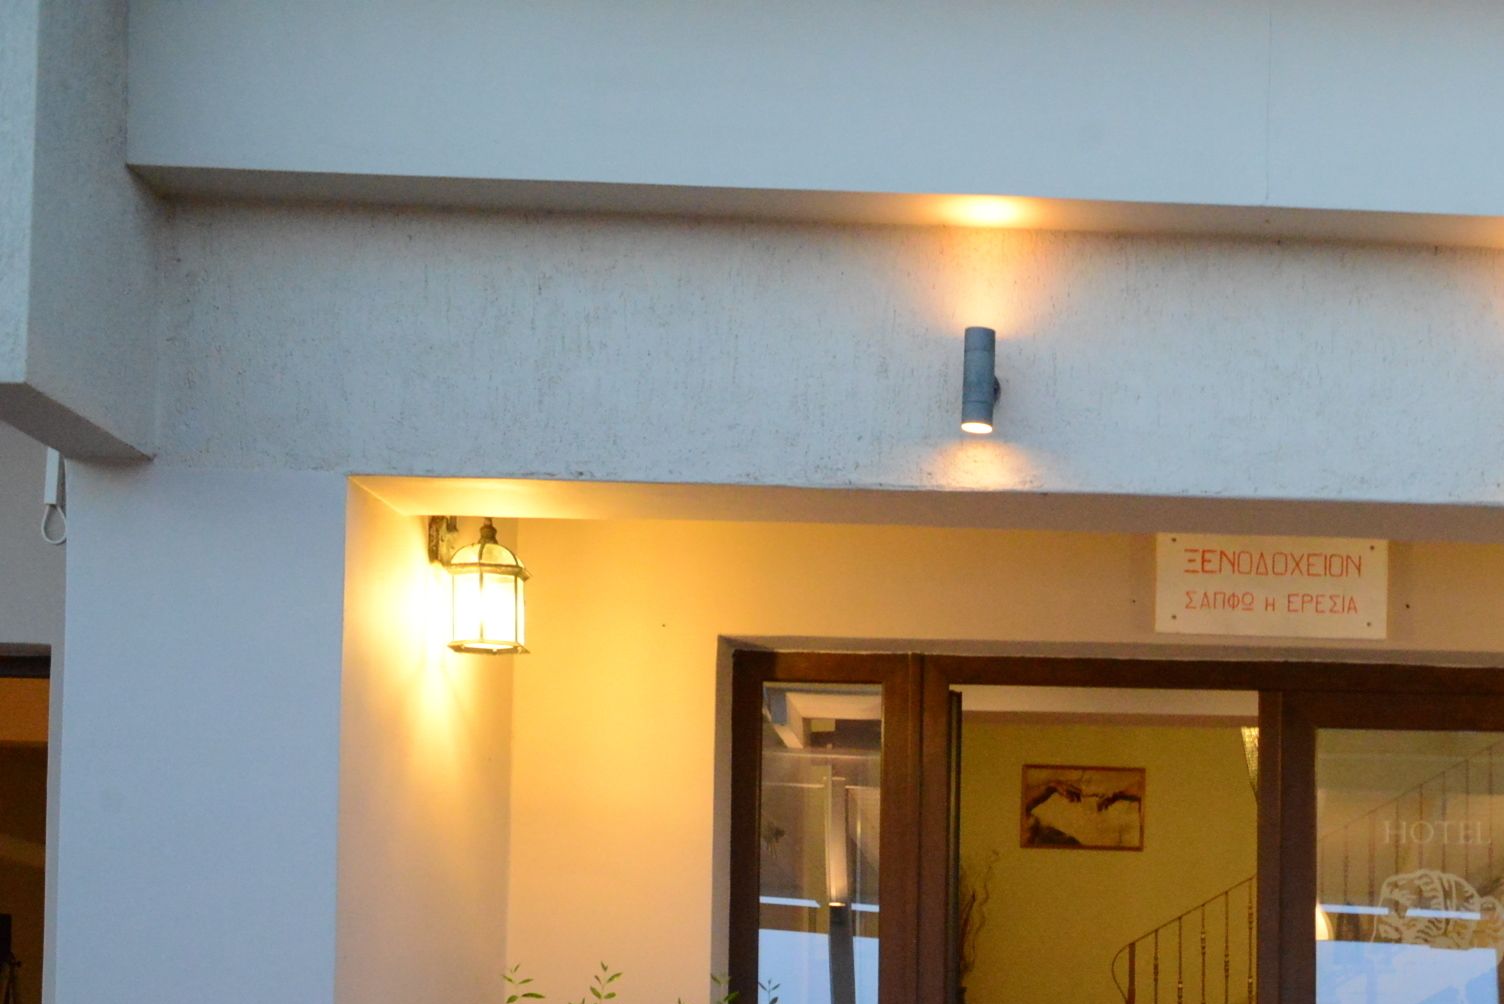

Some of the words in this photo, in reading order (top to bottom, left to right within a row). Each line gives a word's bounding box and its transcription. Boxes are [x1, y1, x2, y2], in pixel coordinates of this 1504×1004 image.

[1183, 548, 1363, 578] ΞΕΝΟΔΟΧΕΙΟΝ
[1184, 590, 1255, 612] ΣΑΠΦΩ
[1286, 592, 1359, 615] ΕΡΕΣΙΑ
[1383, 820, 1490, 845] HOTEL
